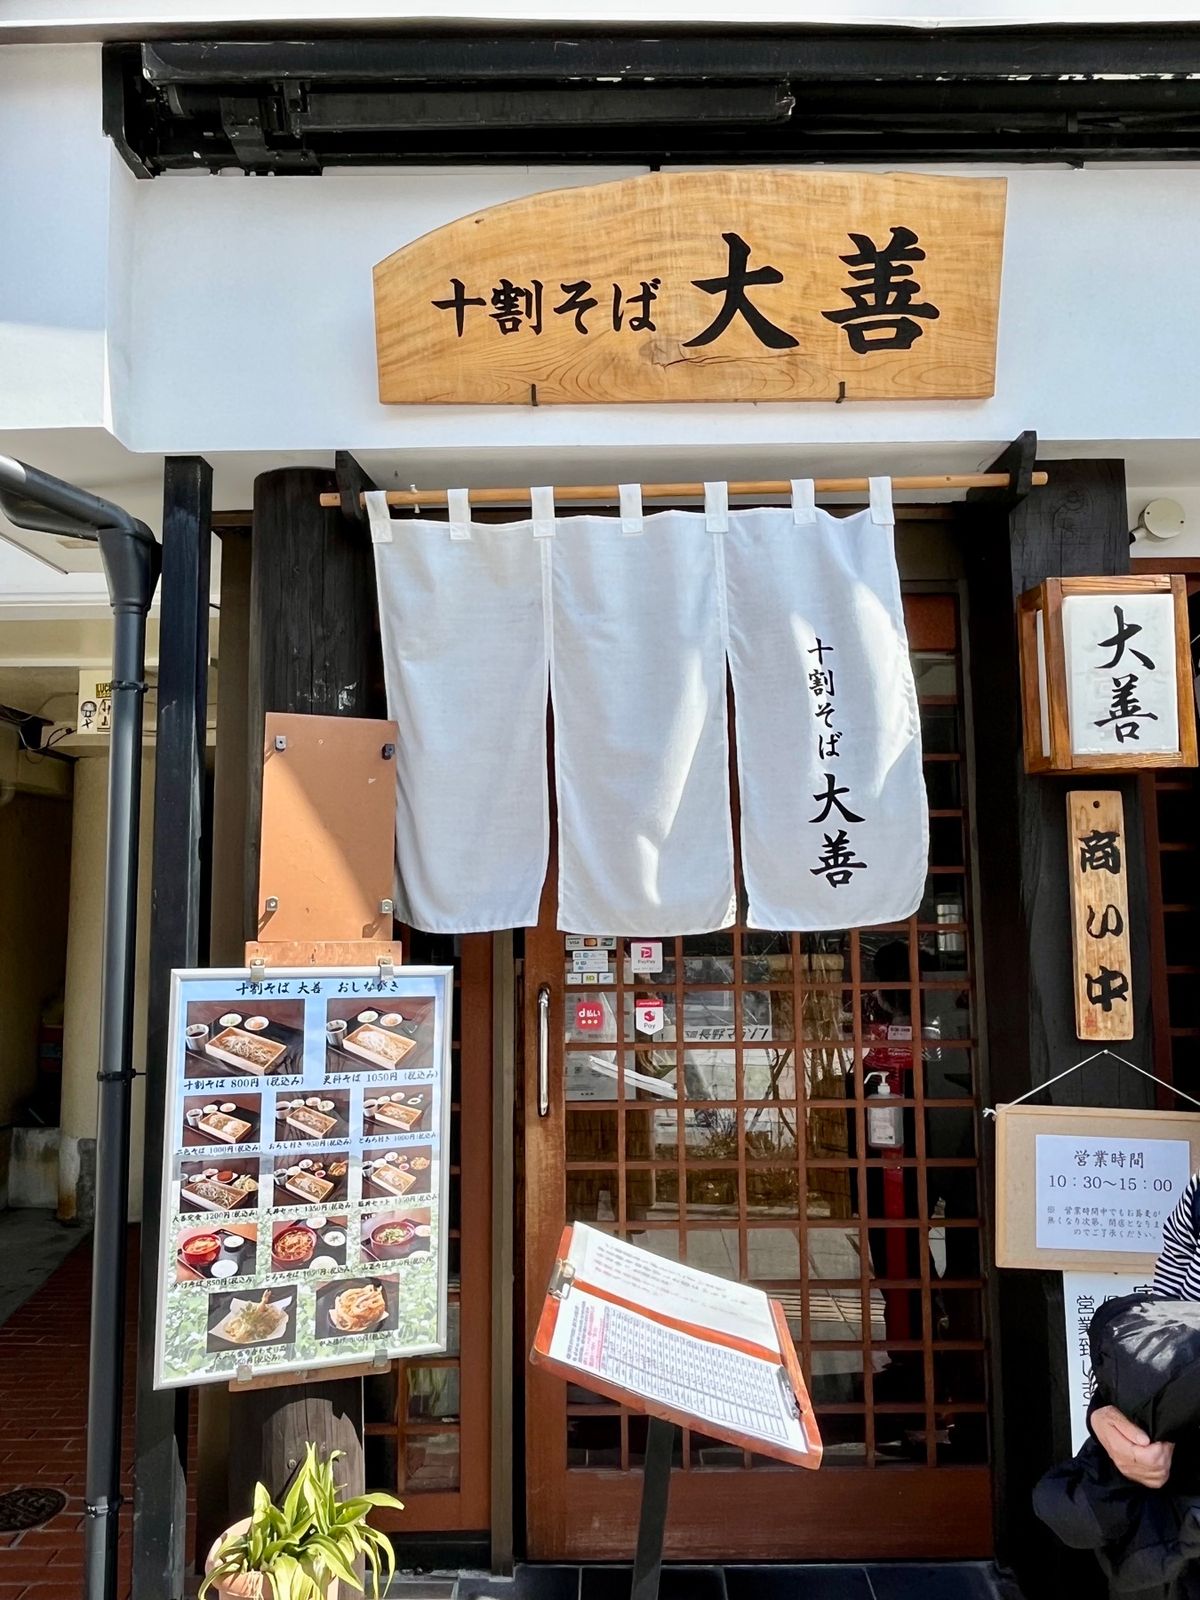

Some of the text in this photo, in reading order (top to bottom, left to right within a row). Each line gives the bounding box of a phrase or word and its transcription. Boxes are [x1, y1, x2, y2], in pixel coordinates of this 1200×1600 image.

[431, 226, 940, 355] 十割そば 大善
[1093, 604, 1158, 743] 大善
[808, 637, 867, 888] 十割そば 大善
[1077, 829, 1129, 1012] 商い中
[235, 981, 399, 995] 十割そば 大善 おしながき
[184, 1079, 225, 1090] 十割そば
[1073, 1149, 1144, 1169] 営業時間
[1047, 1216, 1160, 1229] 無くなり次第、閉店となりま
